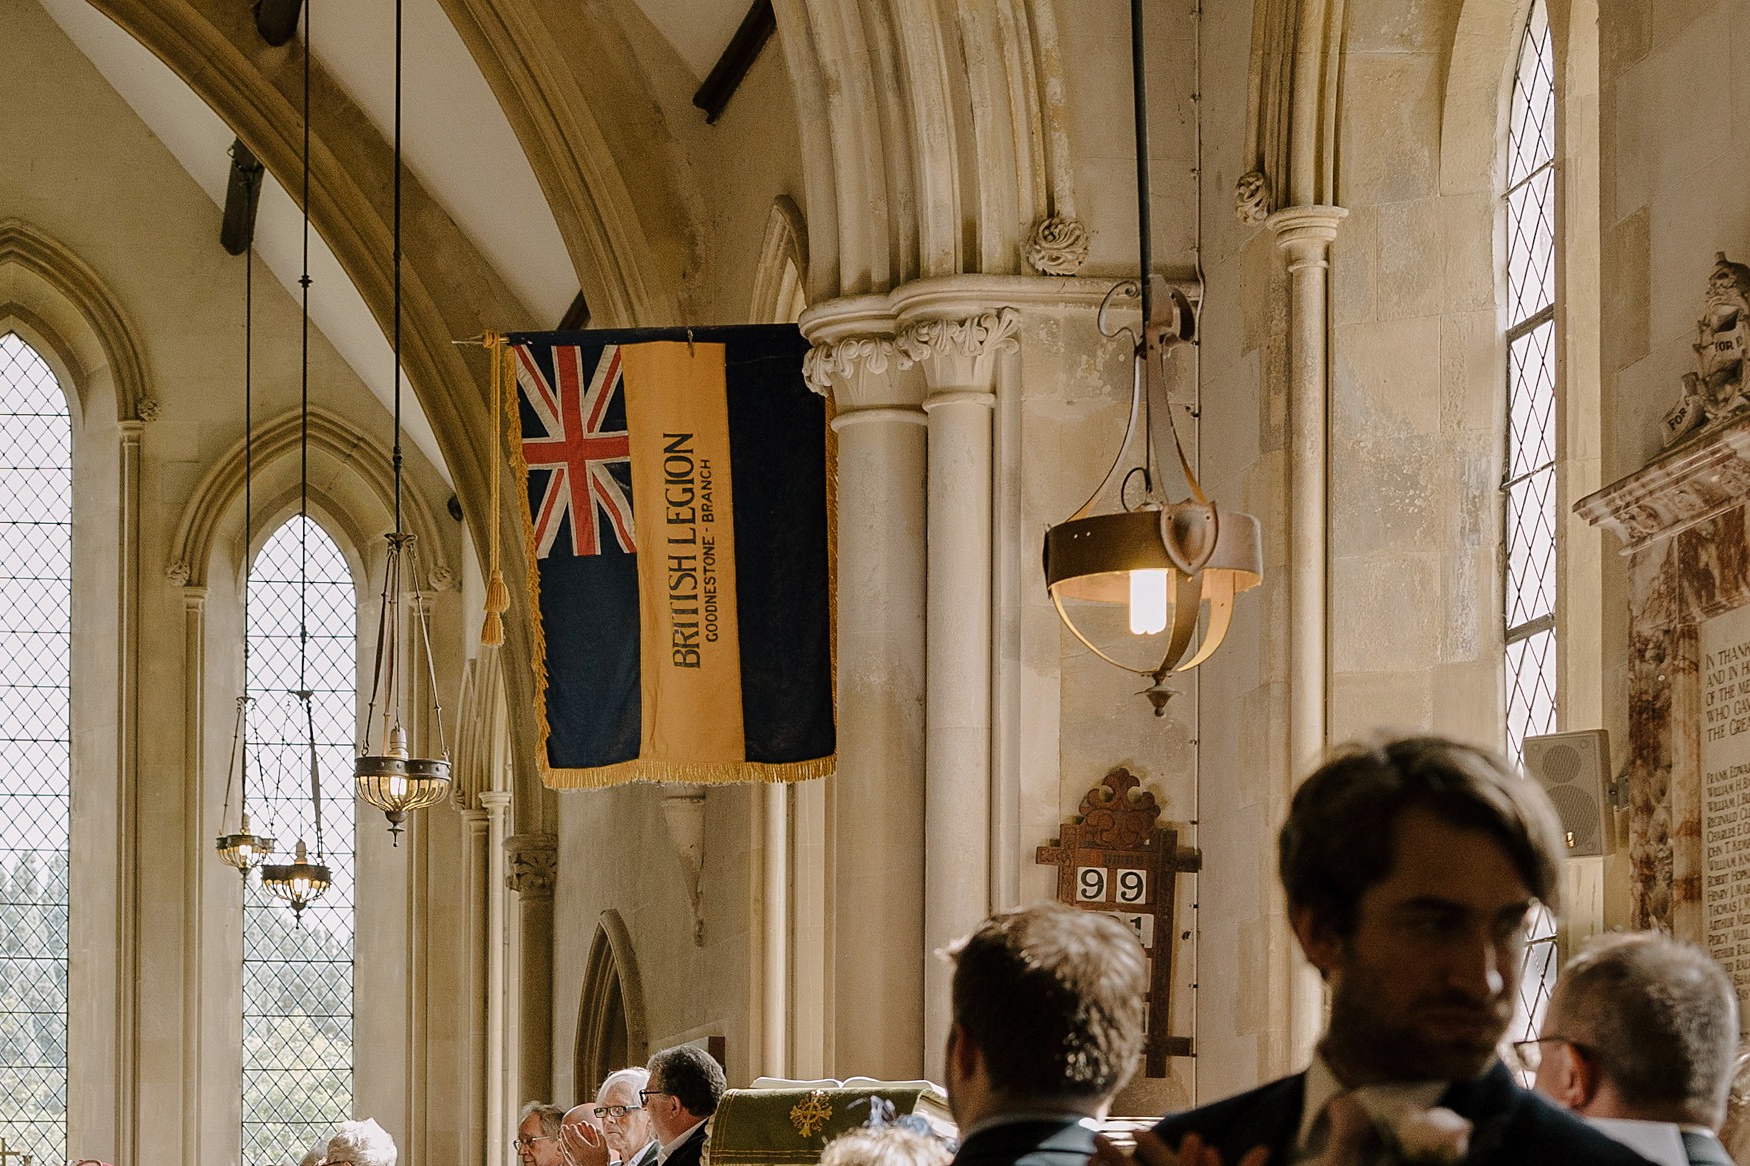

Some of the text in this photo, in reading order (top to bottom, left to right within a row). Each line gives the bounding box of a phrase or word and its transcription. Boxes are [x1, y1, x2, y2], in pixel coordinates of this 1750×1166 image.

[1668, 407, 1687, 431] FOR
[699, 458, 715, 524] BRANCH
[662, 432, 701, 669] BRITISH LEGION
[702, 535, 718, 643] GOODNESTONE
[1706, 653, 1715, 671] IN
[1706, 669, 1726, 689] AND
[1729, 664, 1738, 681] IN
[1706, 690, 1716, 707] OF
[1719, 684, 1735, 702] THE
[1706, 704, 1730, 724] WHO
[1707, 724, 1725, 742] THE
[1707, 770, 1729, 785] FRANK
[1707, 782, 1734, 798] WILLIAM
[1707, 797, 1735, 813] WILLIAM
[1707, 826, 1736, 844] CHARLES
[1707, 846, 1723, 859] JOHN
[1707, 873, 1730, 888] ROBERT
[1707, 888, 1729, 903] HENRY
[1707, 900, 1737, 918] THOMAS
[1709, 916, 1735, 931] ARTHUR
[1707, 931, 1730, 947] PERCY
